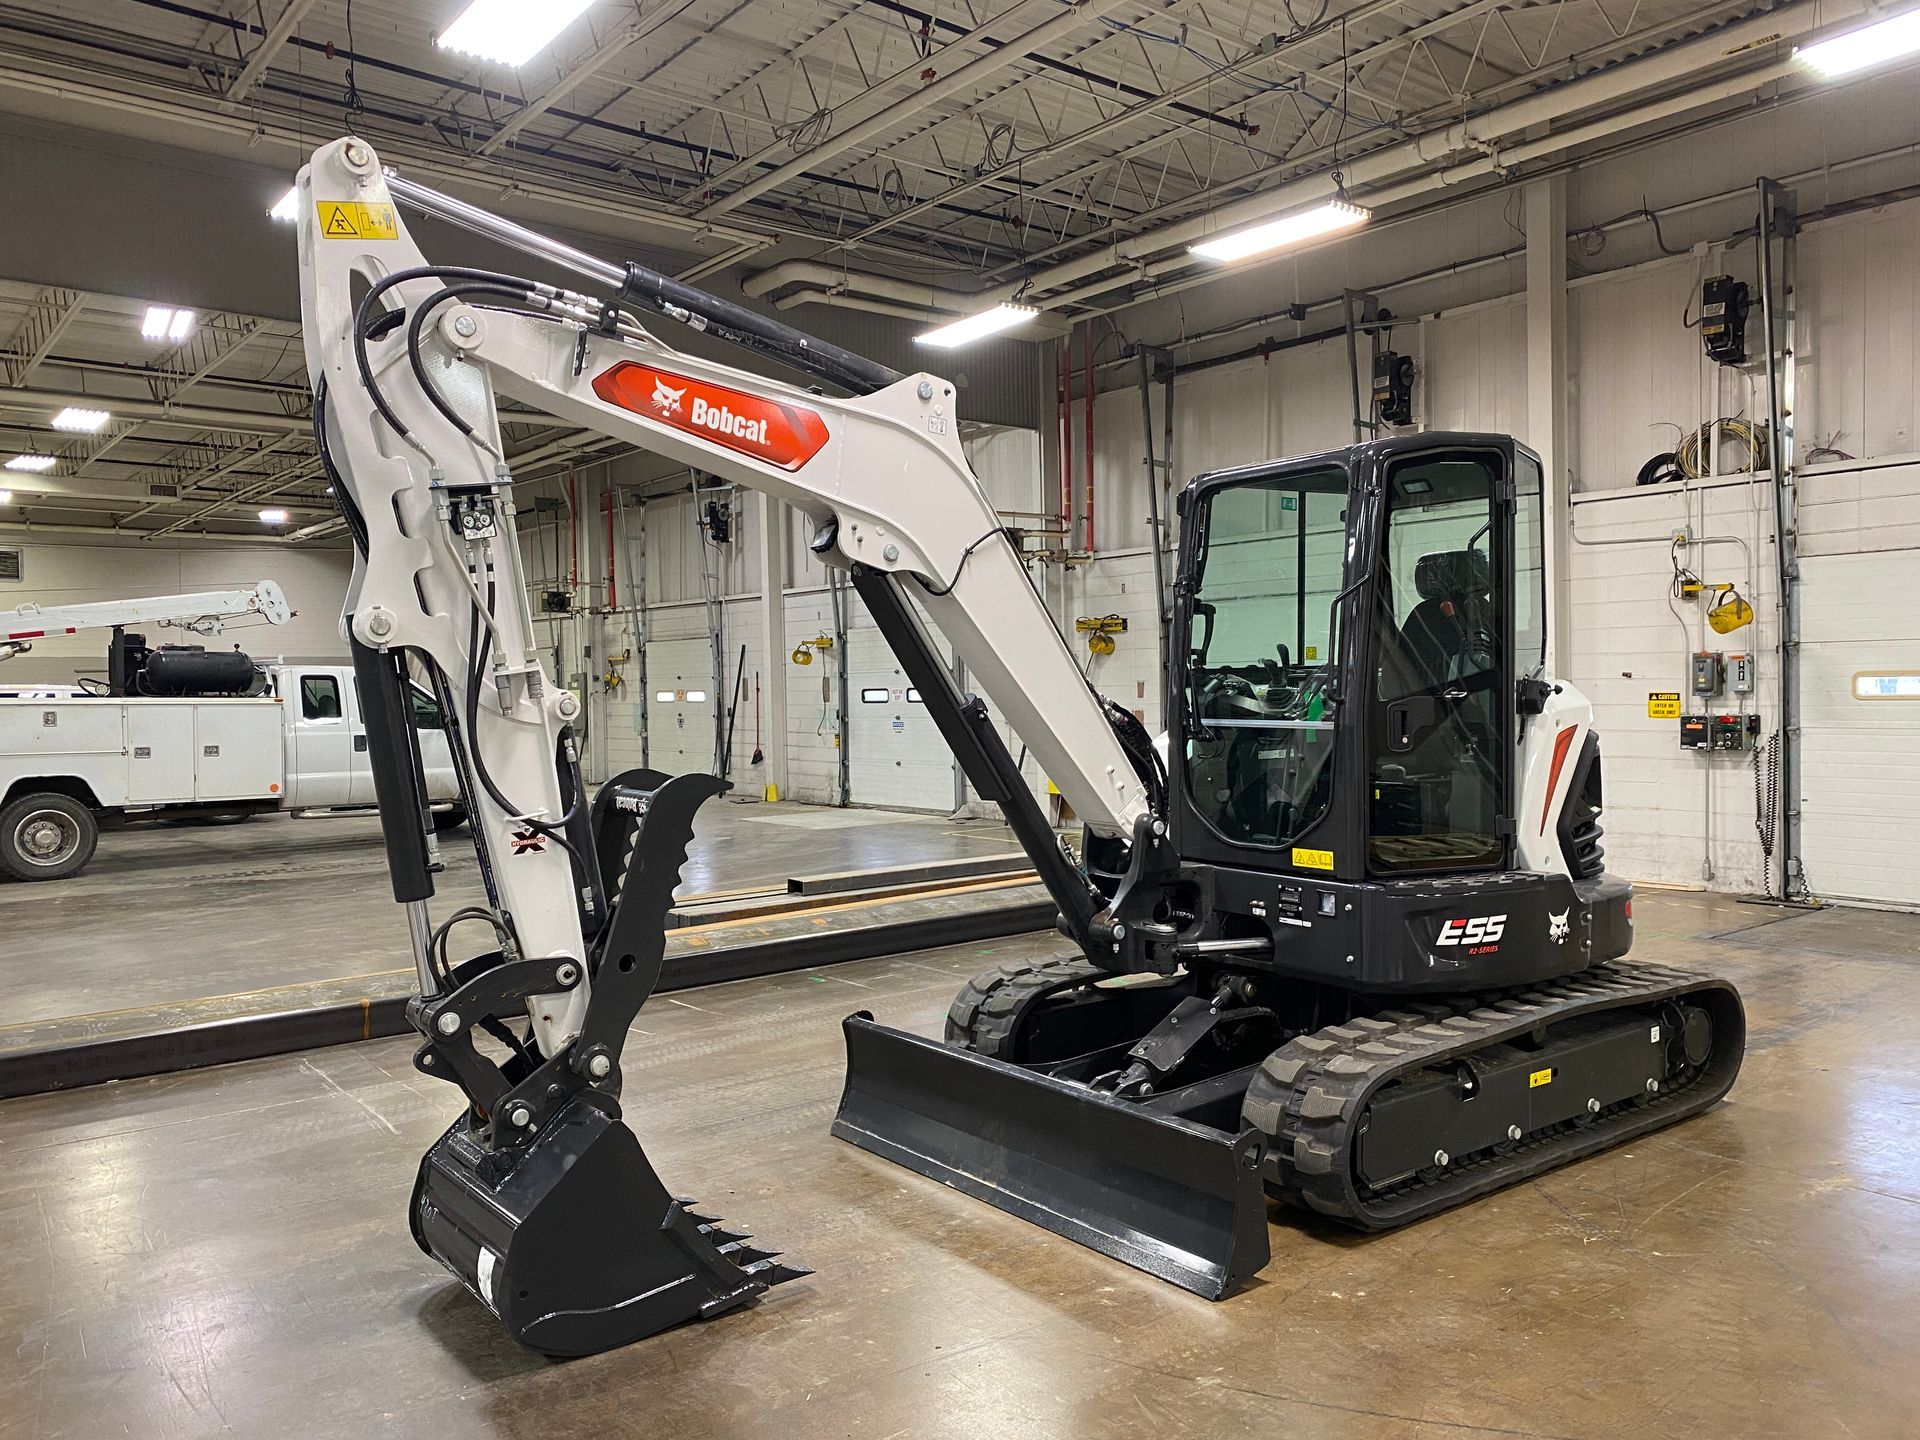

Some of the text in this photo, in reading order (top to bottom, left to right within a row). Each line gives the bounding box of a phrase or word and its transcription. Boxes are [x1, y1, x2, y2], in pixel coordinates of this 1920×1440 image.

[1756, 33, 1781, 45] STEAM
[691, 397, 768, 445] Bobcat
[512, 837, 545, 847] HYDRAULIC
[1435, 914, 1508, 946] E55
[1468, 945, 1499, 955] R2-SERIES
